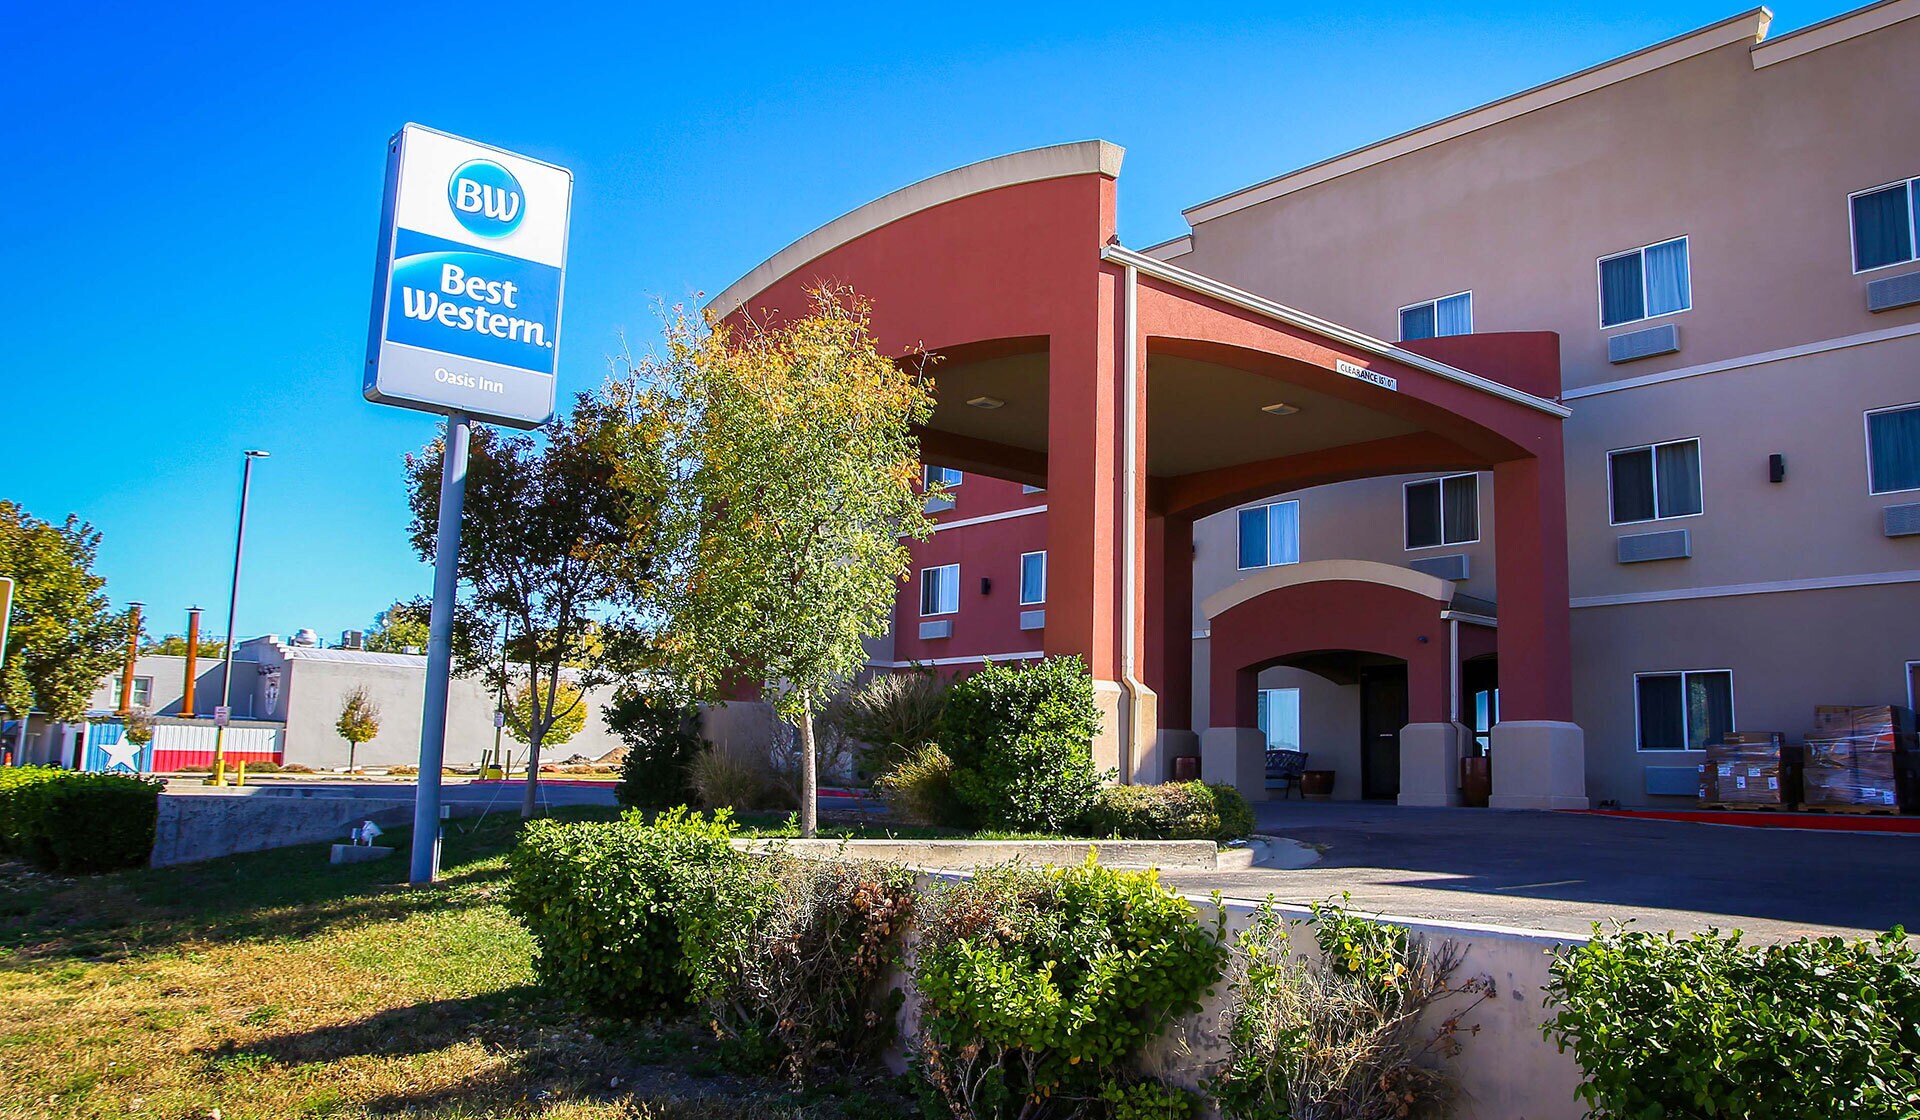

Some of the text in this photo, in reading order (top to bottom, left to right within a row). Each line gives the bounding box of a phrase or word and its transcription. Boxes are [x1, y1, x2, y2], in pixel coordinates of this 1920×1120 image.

[456, 178, 519, 222] BW
[440, 263, 517, 308] Best
[434, 368, 504, 393] Oasis Inn
[1340, 364, 1378, 383] CLEARANCE
